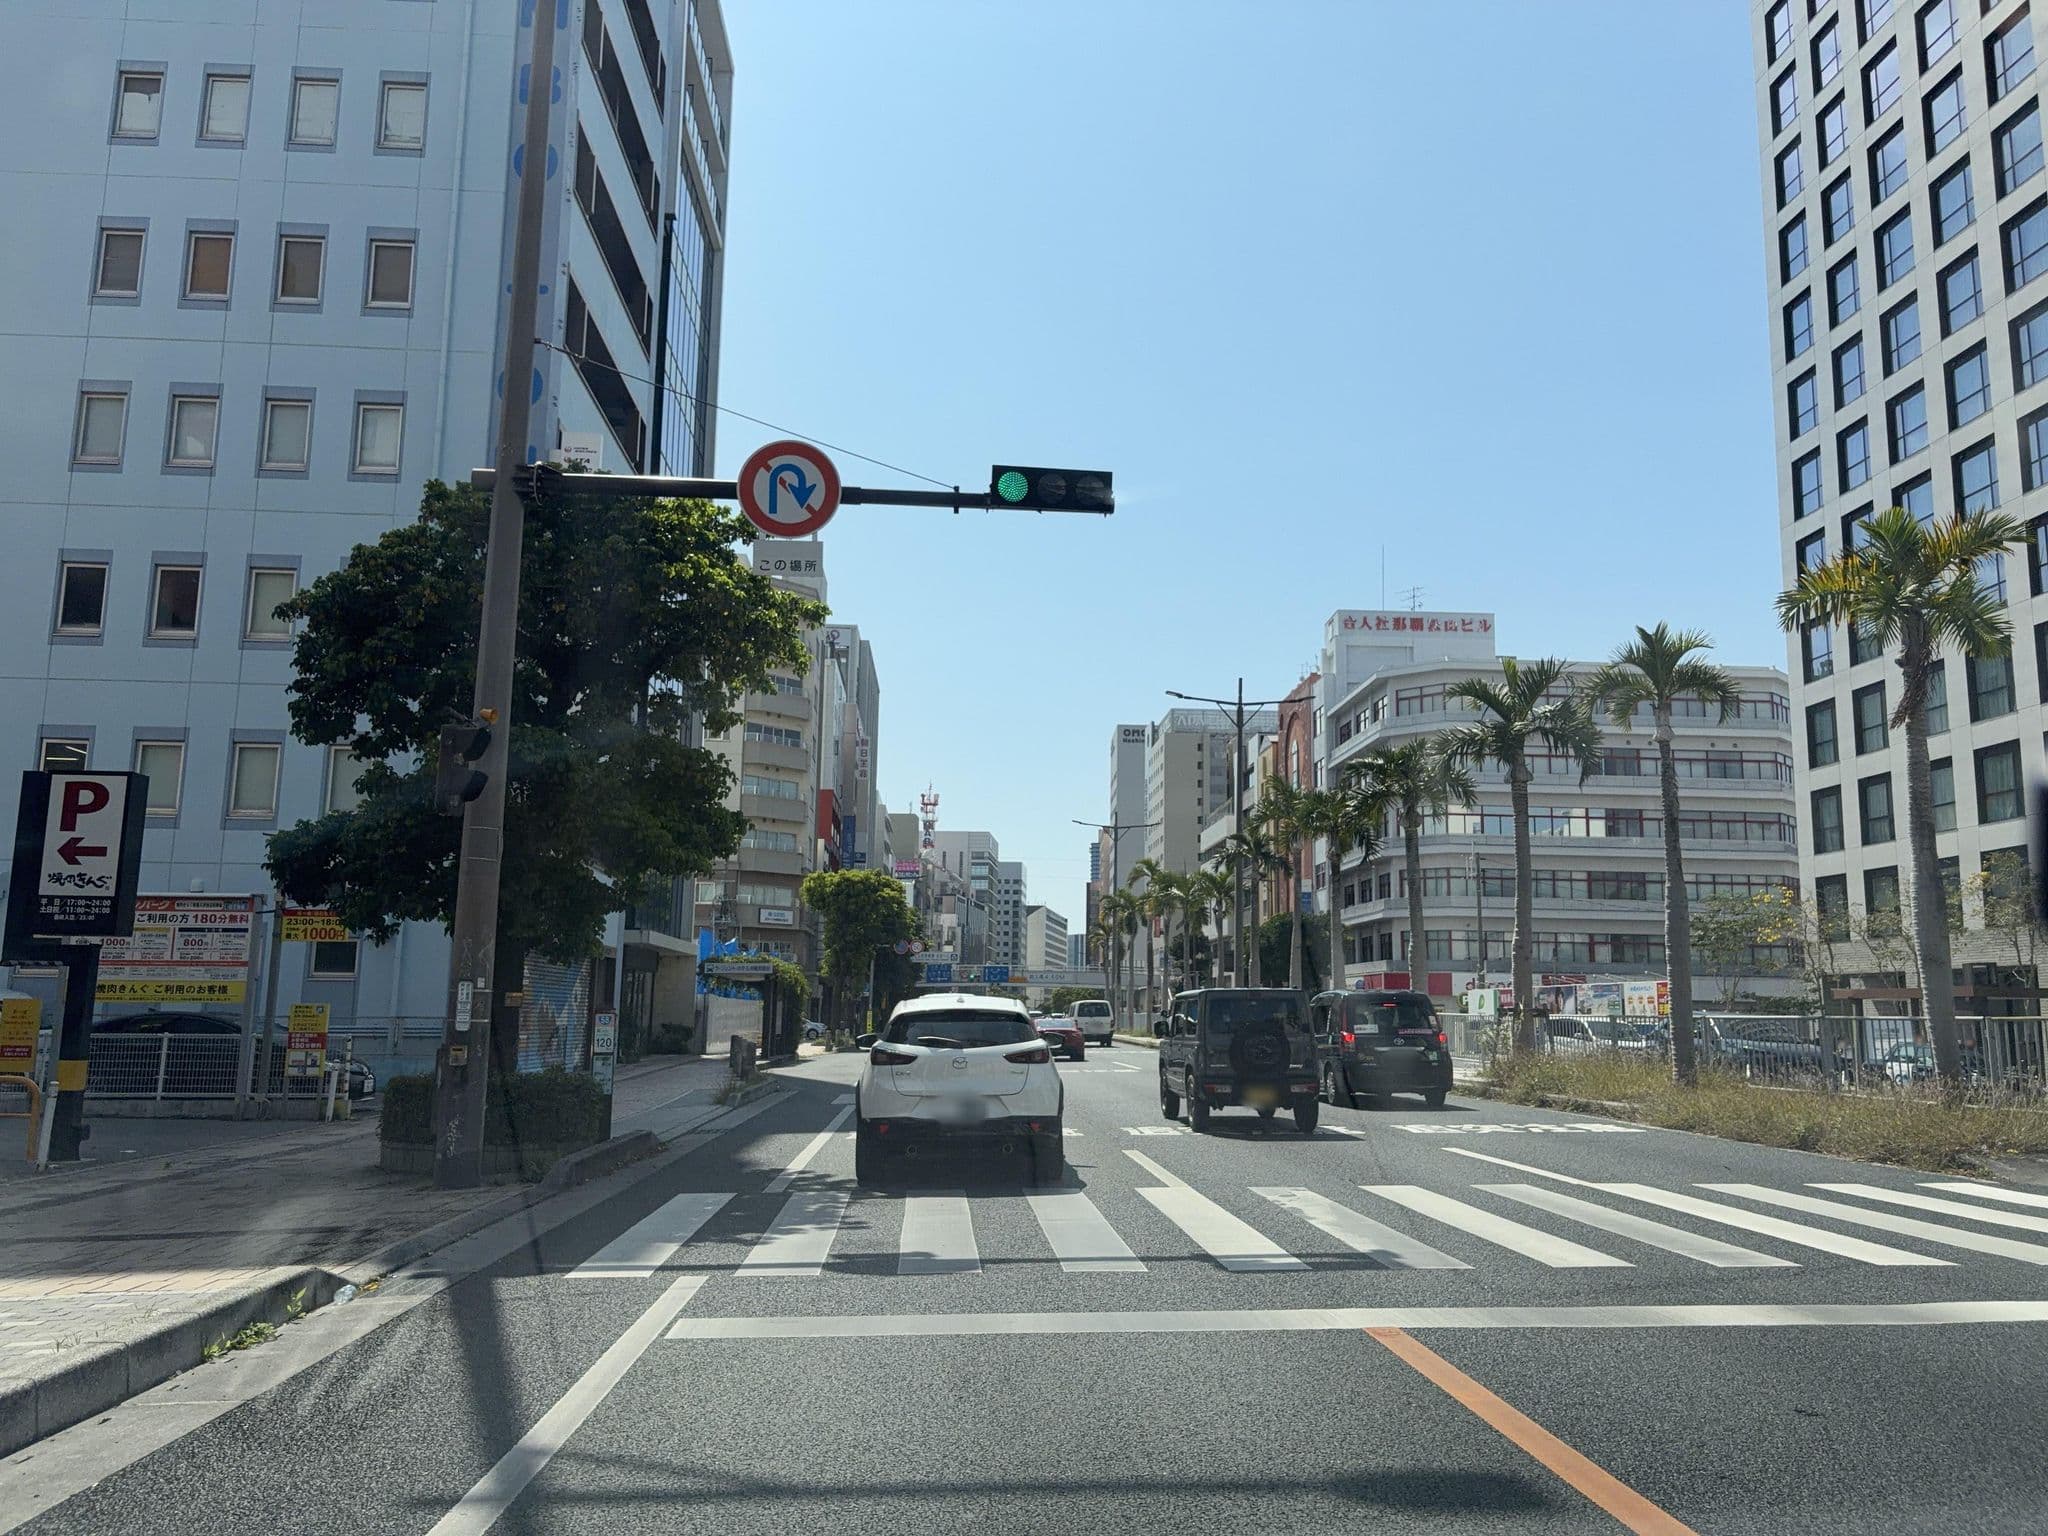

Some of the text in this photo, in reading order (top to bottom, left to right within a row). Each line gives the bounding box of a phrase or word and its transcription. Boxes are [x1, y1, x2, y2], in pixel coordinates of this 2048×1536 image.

[759, 559, 817, 572] この場所
[59, 780, 111, 832] P
[136, 913, 250, 924] ご利用の方 180分無料
[301, 927, 345, 940] 1000円
[97, 984, 229, 995] 焼肉きんぐ ご利用のお客様
[596, 1037, 612, 1048] 120
